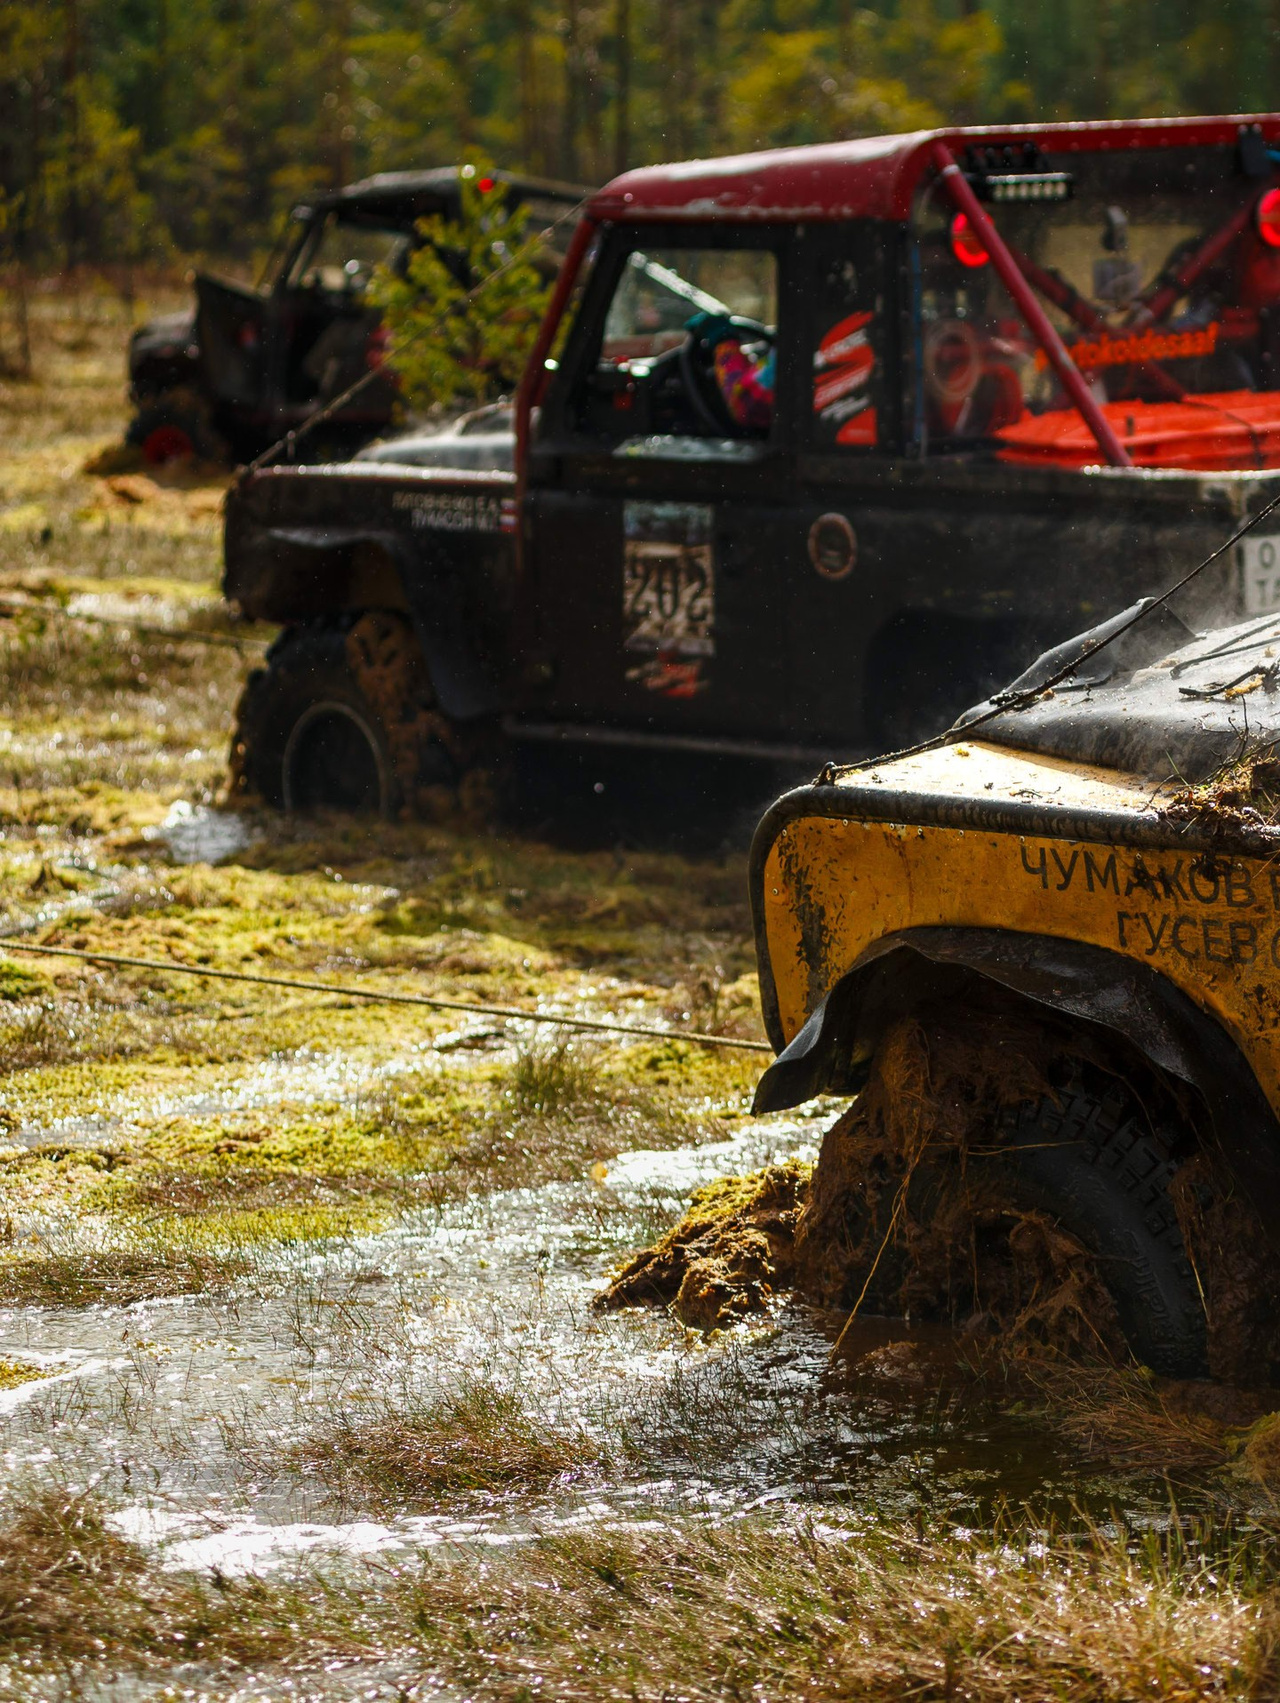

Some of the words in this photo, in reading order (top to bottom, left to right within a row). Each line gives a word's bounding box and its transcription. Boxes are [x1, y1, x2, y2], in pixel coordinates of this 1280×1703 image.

[629, 556, 709, 622] 202
[1020, 846, 1259, 910] ЧУМАКОВ
[1116, 910, 1259, 965] ГУСЕВ
